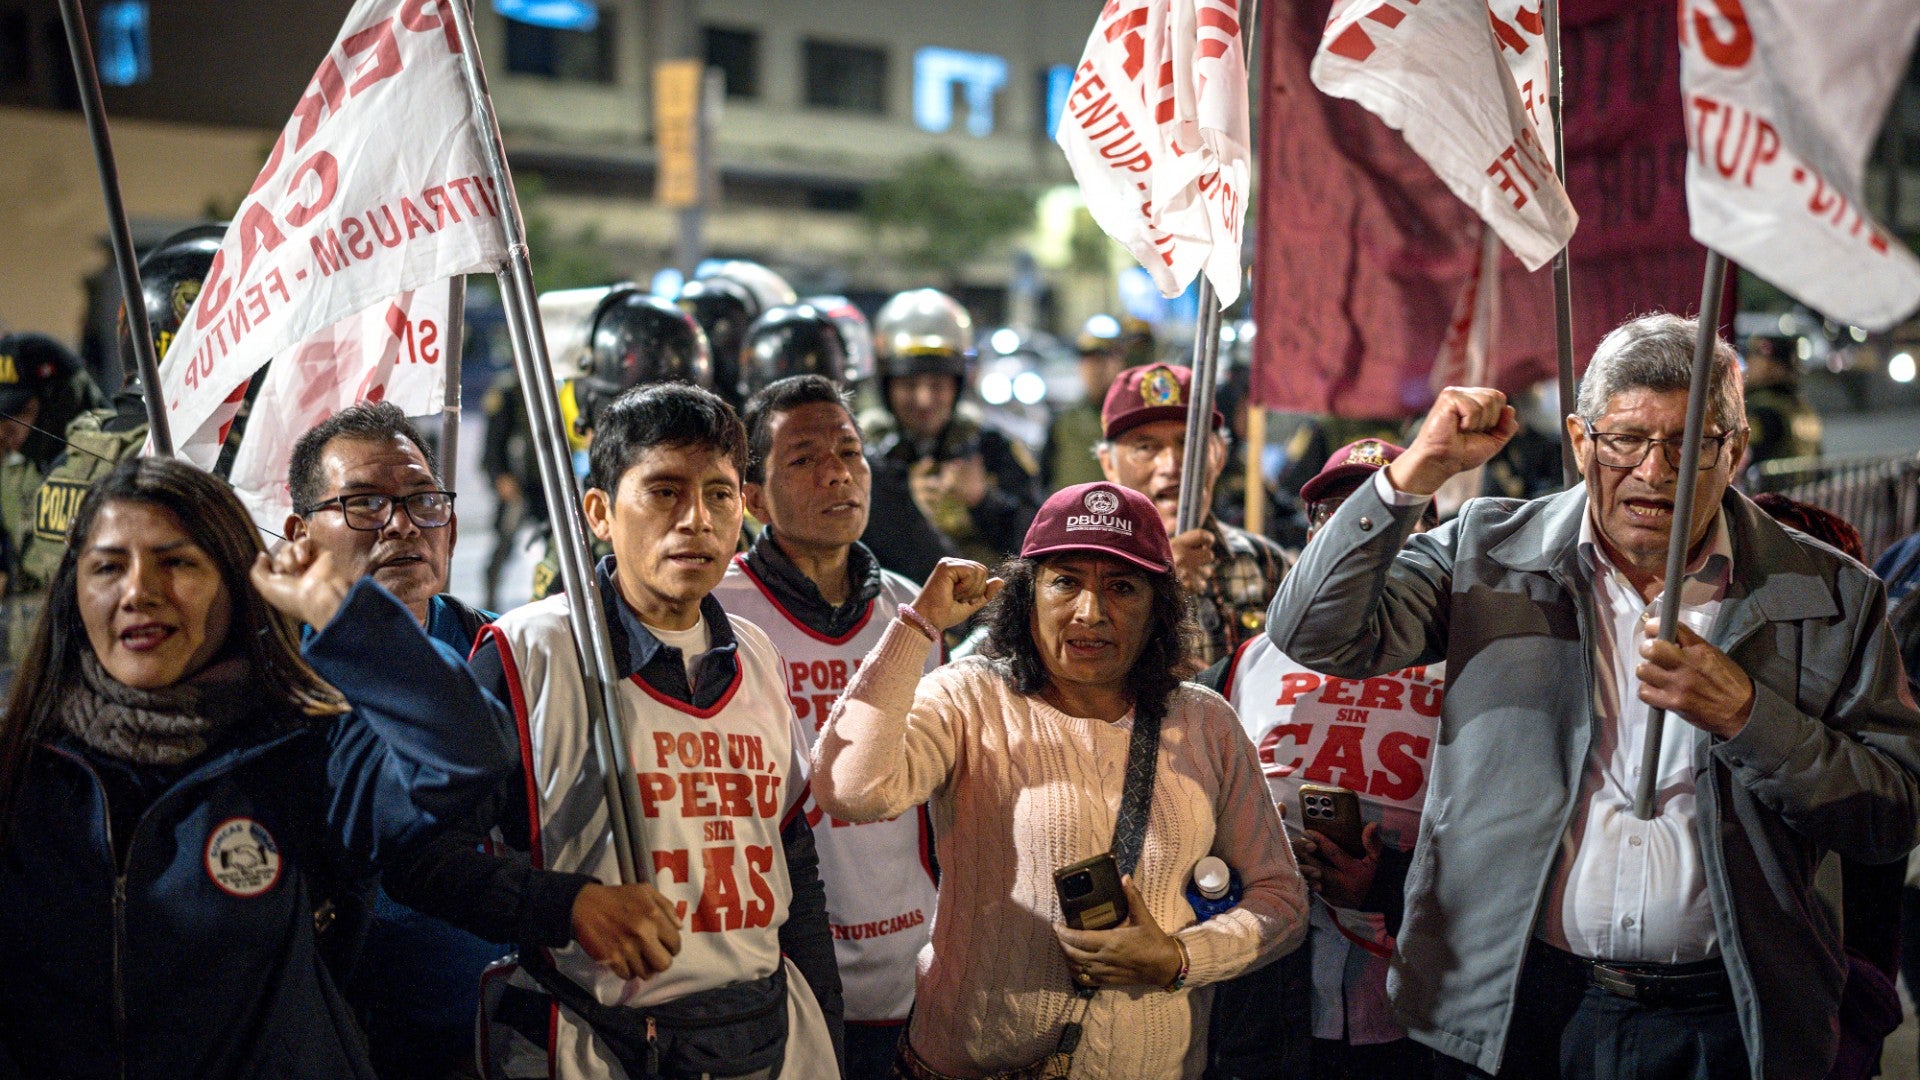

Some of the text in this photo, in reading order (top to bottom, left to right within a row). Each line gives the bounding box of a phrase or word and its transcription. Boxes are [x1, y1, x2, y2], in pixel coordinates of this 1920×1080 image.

[1686, 96, 1781, 189] TUP
[1066, 514, 1133, 531] DBUUNI
[790, 659, 848, 692] POR
[1276, 672, 1445, 718] PERÚ
[1336, 708, 1370, 724] SIN
[653, 731, 765, 770] POR UN
[1258, 723, 1431, 801] CAS
[637, 761, 782, 819] PERÚ
[703, 820, 735, 841] SIN
[652, 844, 776, 933] CAS
